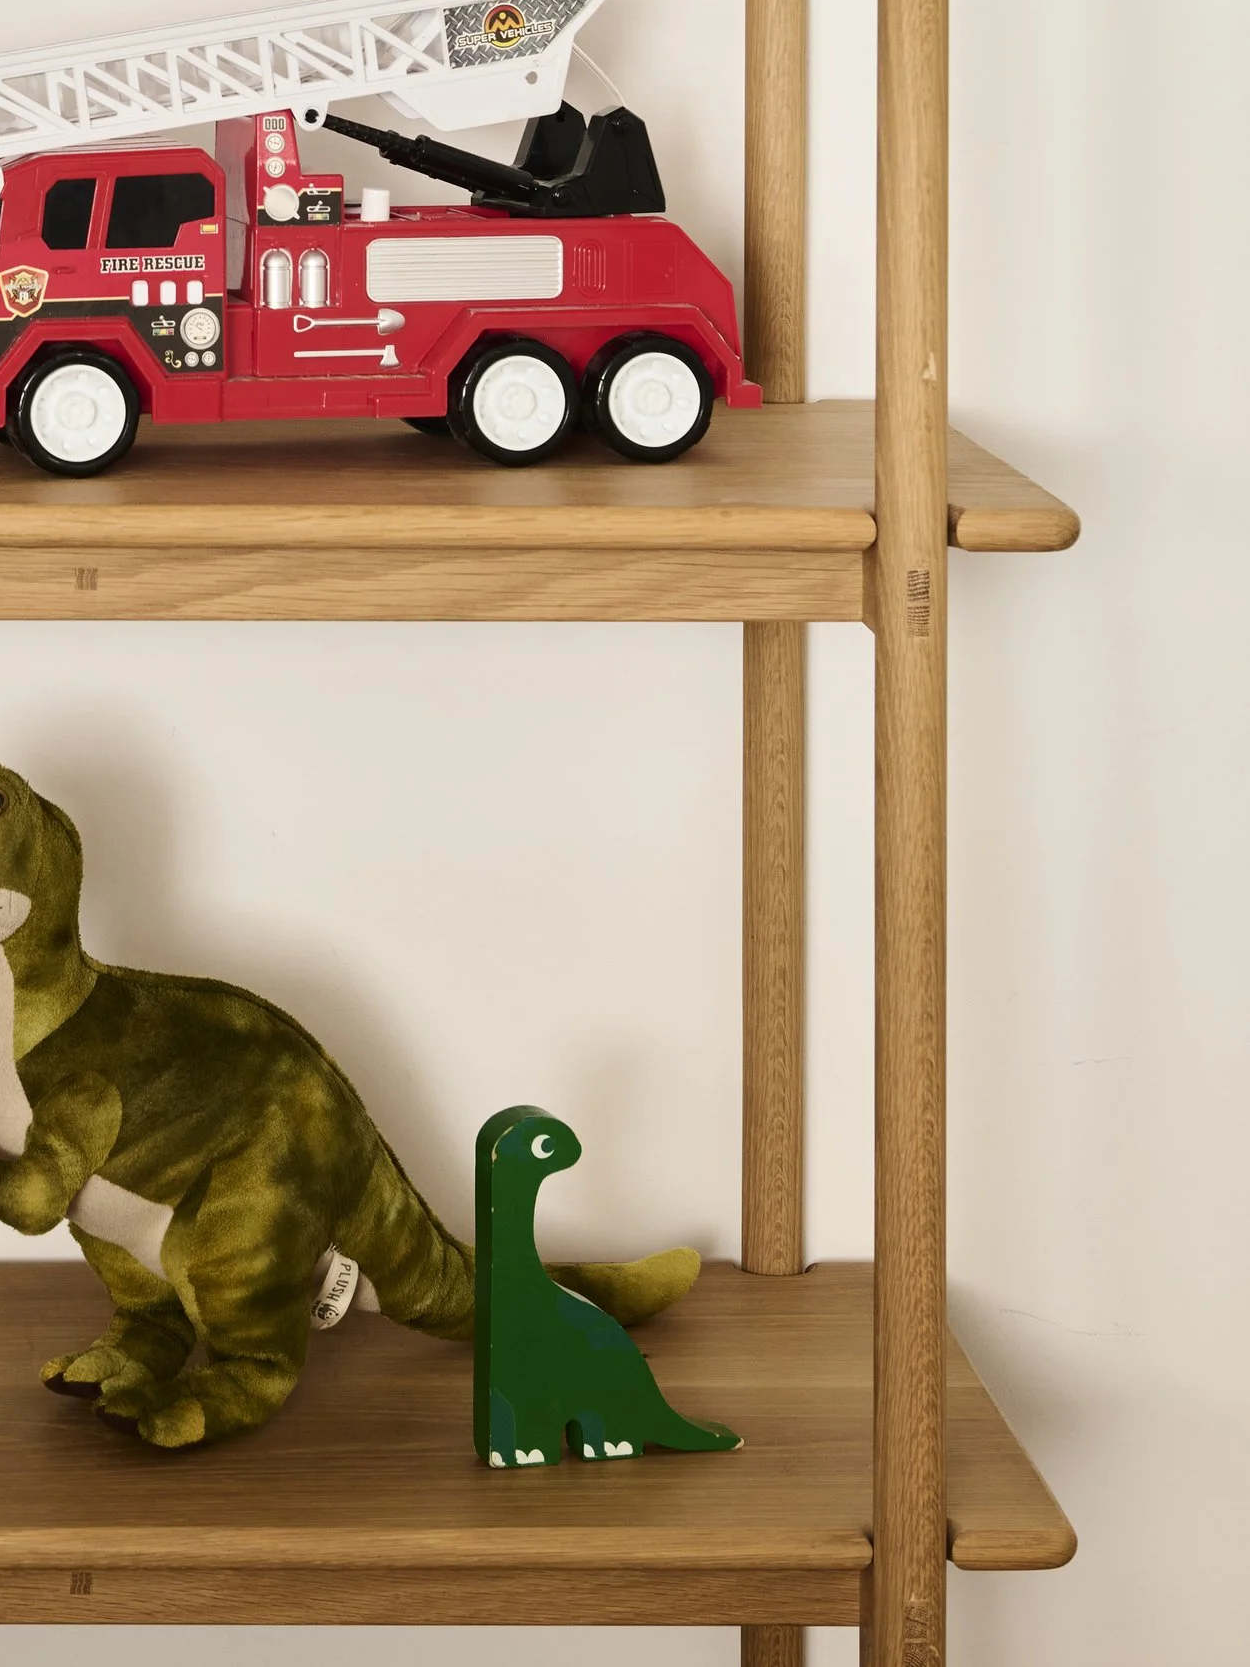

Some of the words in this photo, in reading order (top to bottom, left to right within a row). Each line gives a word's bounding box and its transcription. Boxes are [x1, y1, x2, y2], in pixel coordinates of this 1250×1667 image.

[458, 32, 497, 48] SUPER
[500, 21, 554, 40] VEHICLES
[101, 257, 139, 273] FIRE
[143, 255, 205, 272] RESCUE
[326, 1262, 352, 1302] PLUSH
